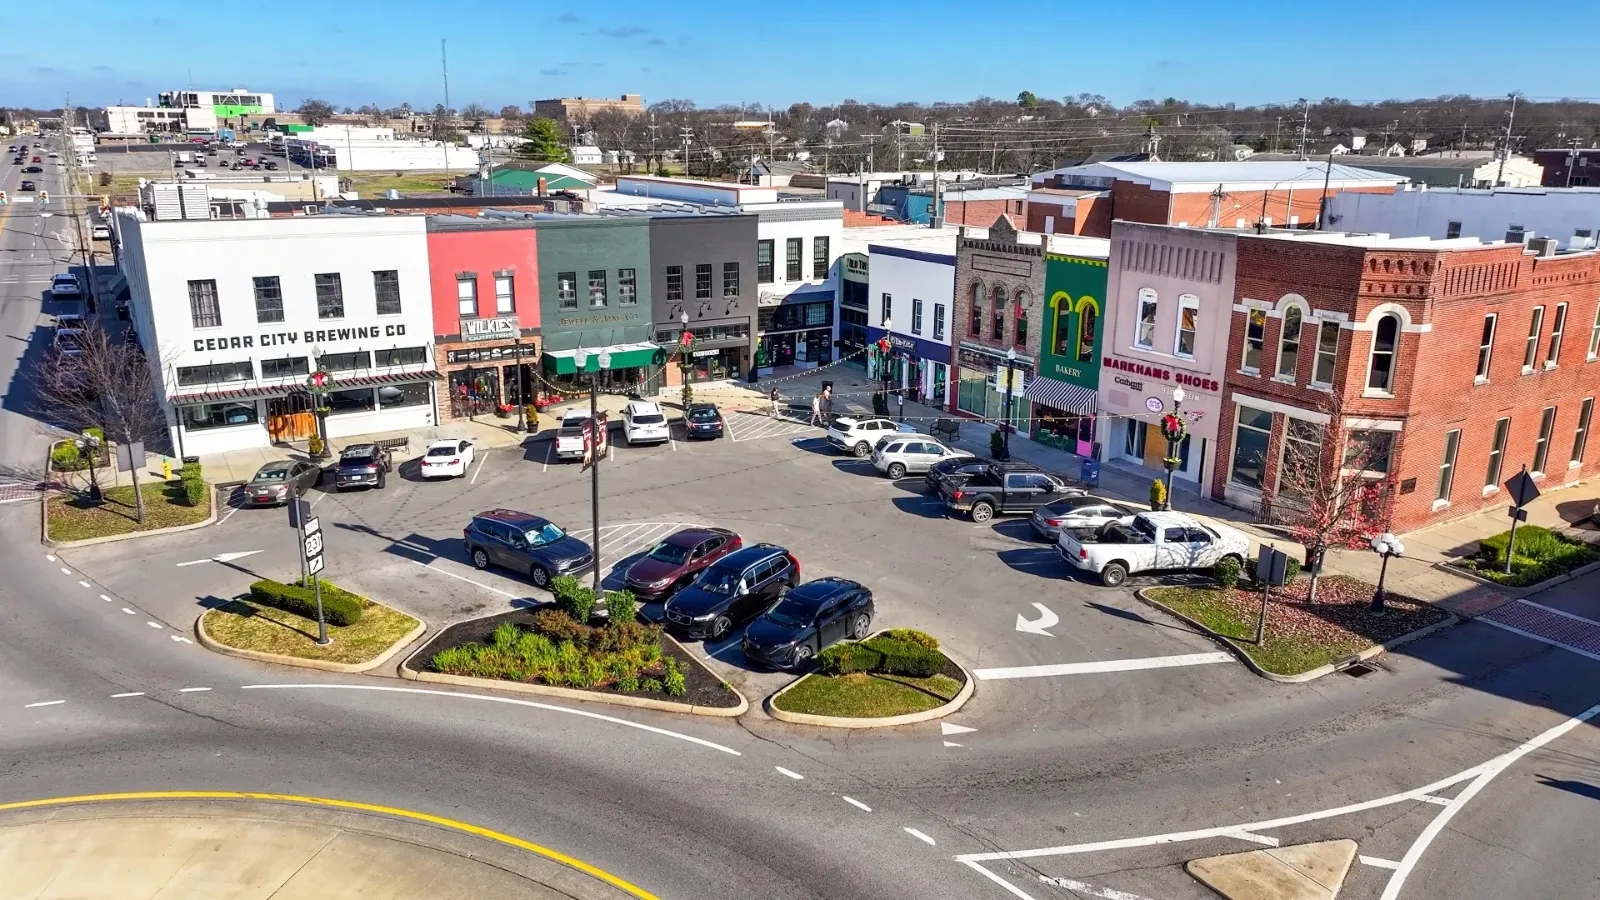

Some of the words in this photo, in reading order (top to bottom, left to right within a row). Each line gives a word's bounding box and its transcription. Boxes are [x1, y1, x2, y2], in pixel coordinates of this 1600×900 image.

[193, 335, 254, 352] CEDAR
[260, 331, 298, 347] CITY
[304, 326, 380, 343] BREWING
[386, 324, 406, 337] CO
[1056, 364, 1082, 378] BAKERY
[1103, 357, 1170, 381] MARKHAMS
[1175, 373, 1219, 392] SHOES
[1163, 388, 1200, 402] FLOHEIM
[307, 536, 321, 553] 231
